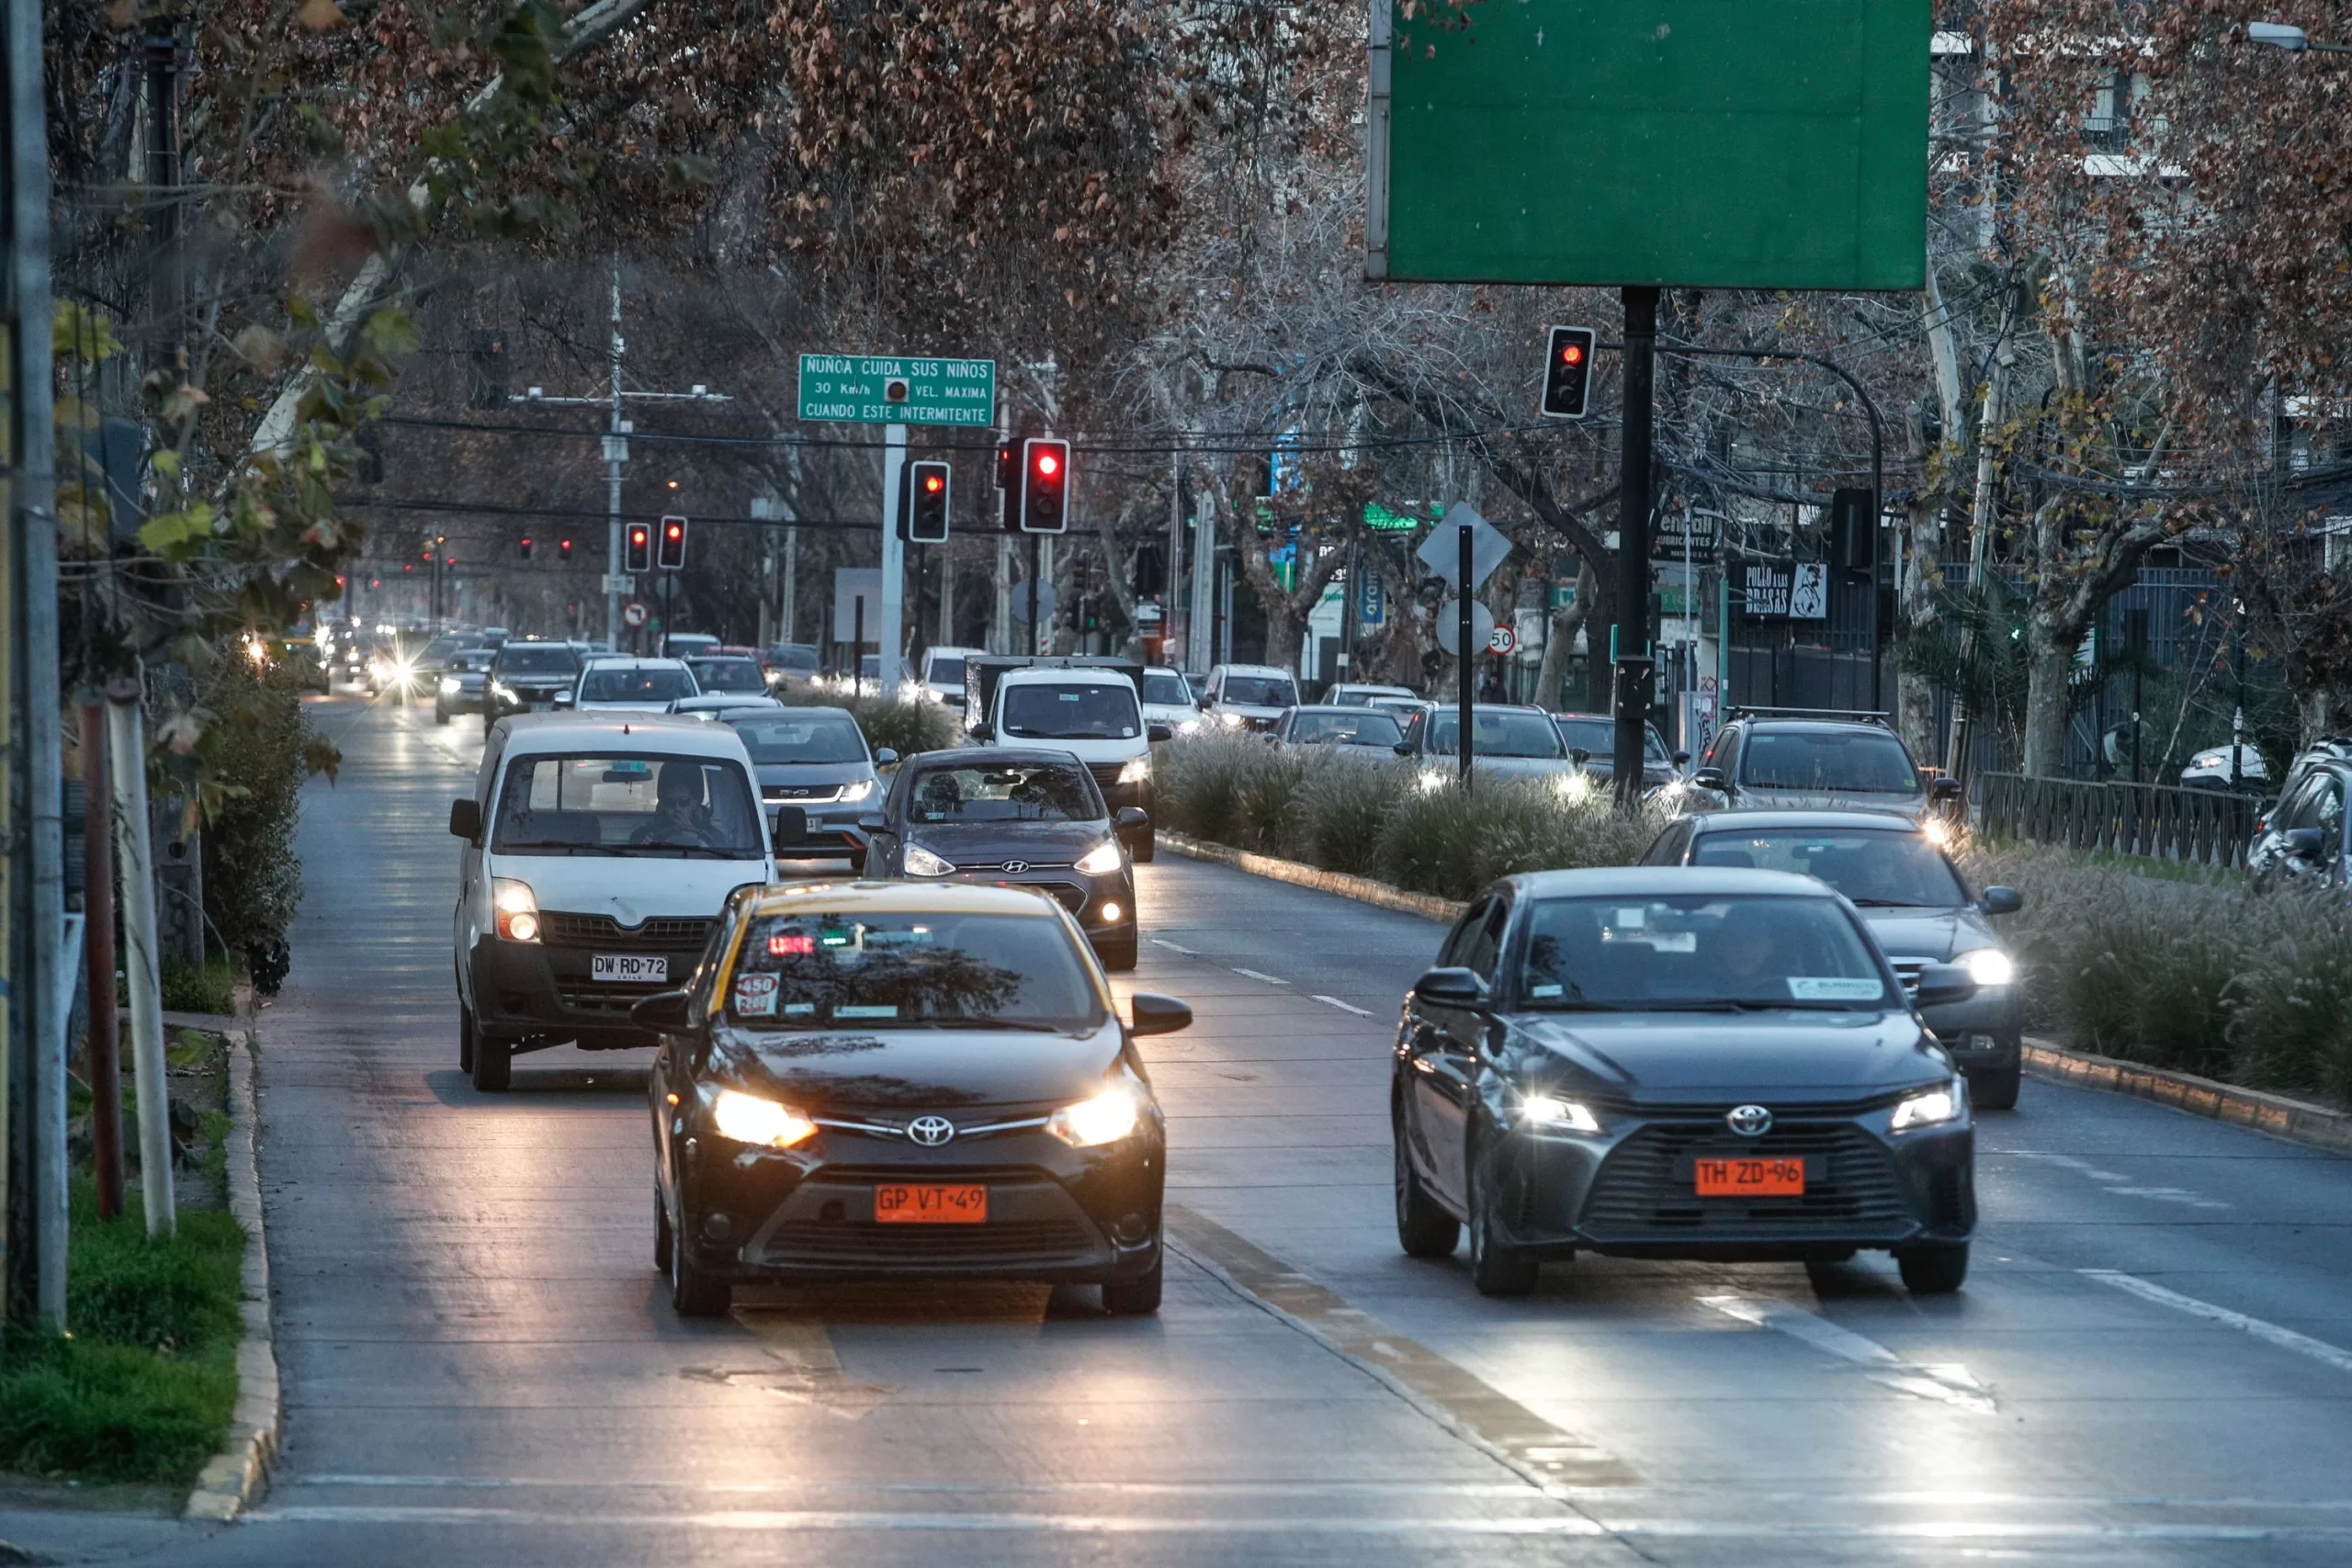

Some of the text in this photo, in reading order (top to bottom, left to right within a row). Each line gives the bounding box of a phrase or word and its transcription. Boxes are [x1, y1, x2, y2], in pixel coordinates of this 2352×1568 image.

[807, 356, 988, 378] ÑUÑOA CUIDA SUS NIÑOS
[815, 382, 831, 394] 30
[916, 386, 939, 398] VEL.
[945, 387, 987, 400] MAXIMA
[806, 403, 986, 422] CUANDO ESTE INTERMITENTE
[1660, 513, 1713, 534] enall
[1659, 536, 1711, 547] UBRICNTES
[1747, 566, 1772, 587] POLLO
[1778, 573, 1789, 587] LAS
[1746, 588, 1787, 614] BRASAS
[1492, 633, 1511, 647] 50
